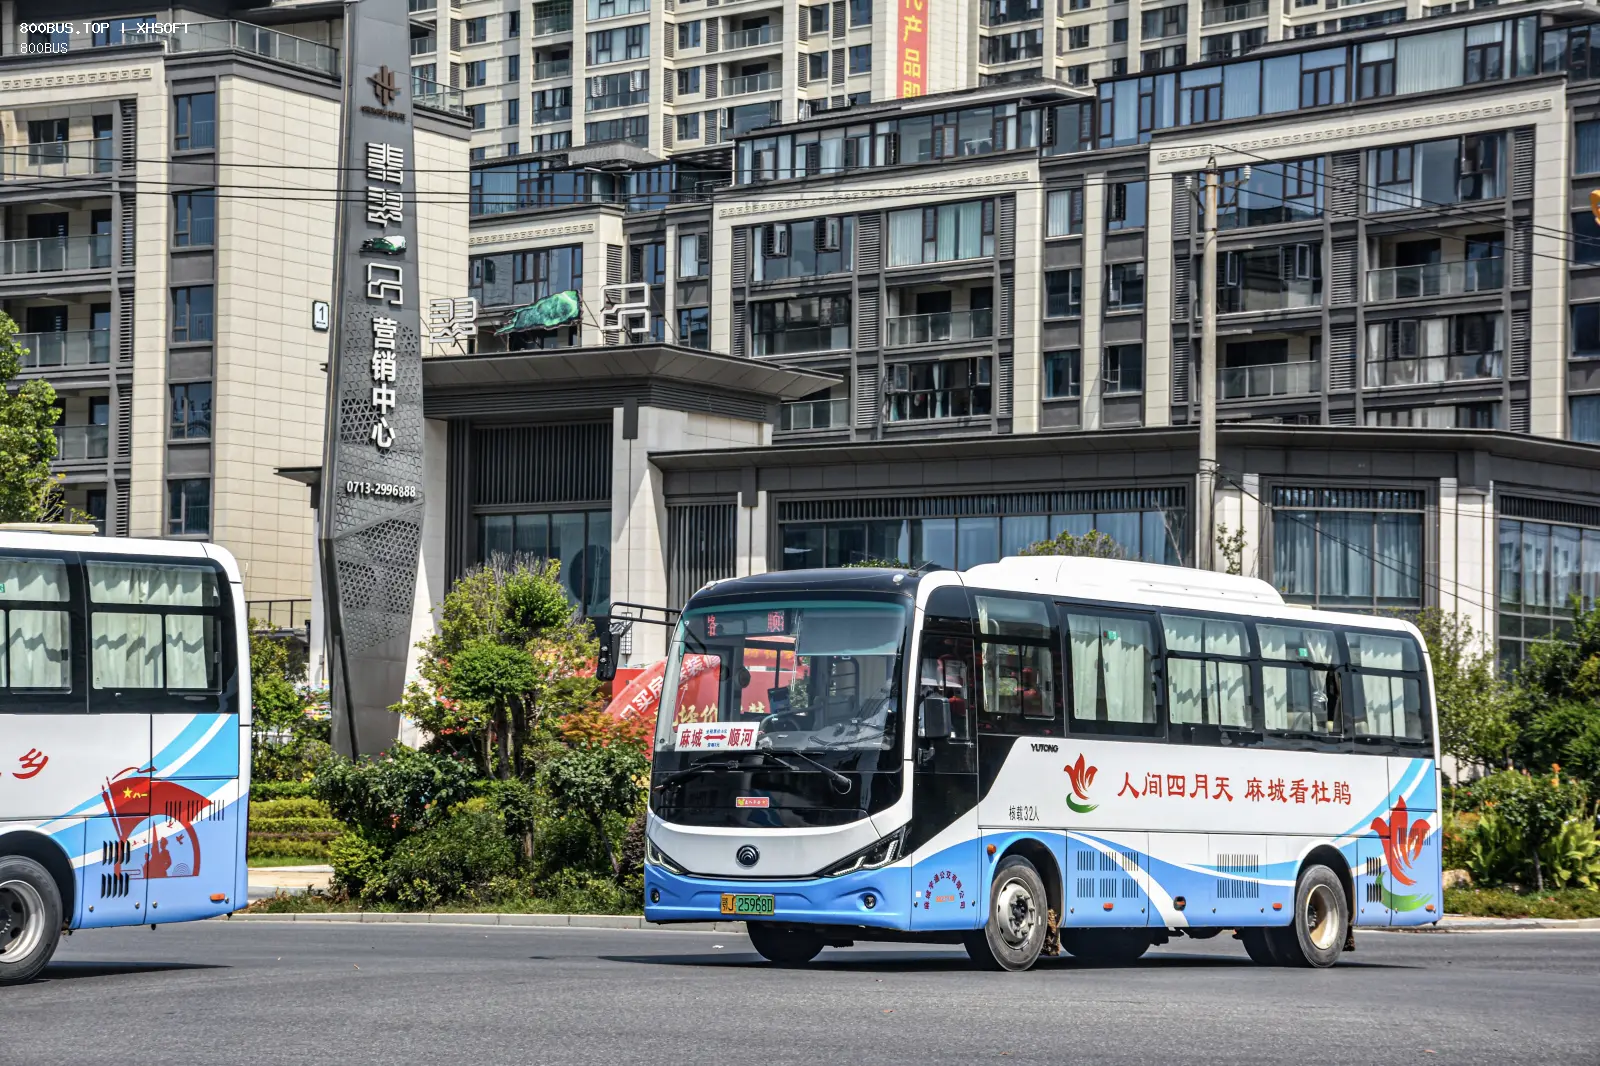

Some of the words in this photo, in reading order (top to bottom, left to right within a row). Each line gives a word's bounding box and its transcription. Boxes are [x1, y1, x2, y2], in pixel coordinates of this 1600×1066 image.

[371, 317, 398, 449] 营销中心
[346, 480, 416, 498] 0713-2996888
[680, 729, 704, 748] 麻城
[728, 728, 755, 747] 顺河
[1030, 743, 1059, 753] YUTONG
[1117, 771, 1234, 802] 人间四月天
[1244, 776, 1352, 806] 麻城看杜鹃
[1008, 804, 1040, 822] 核载32人
